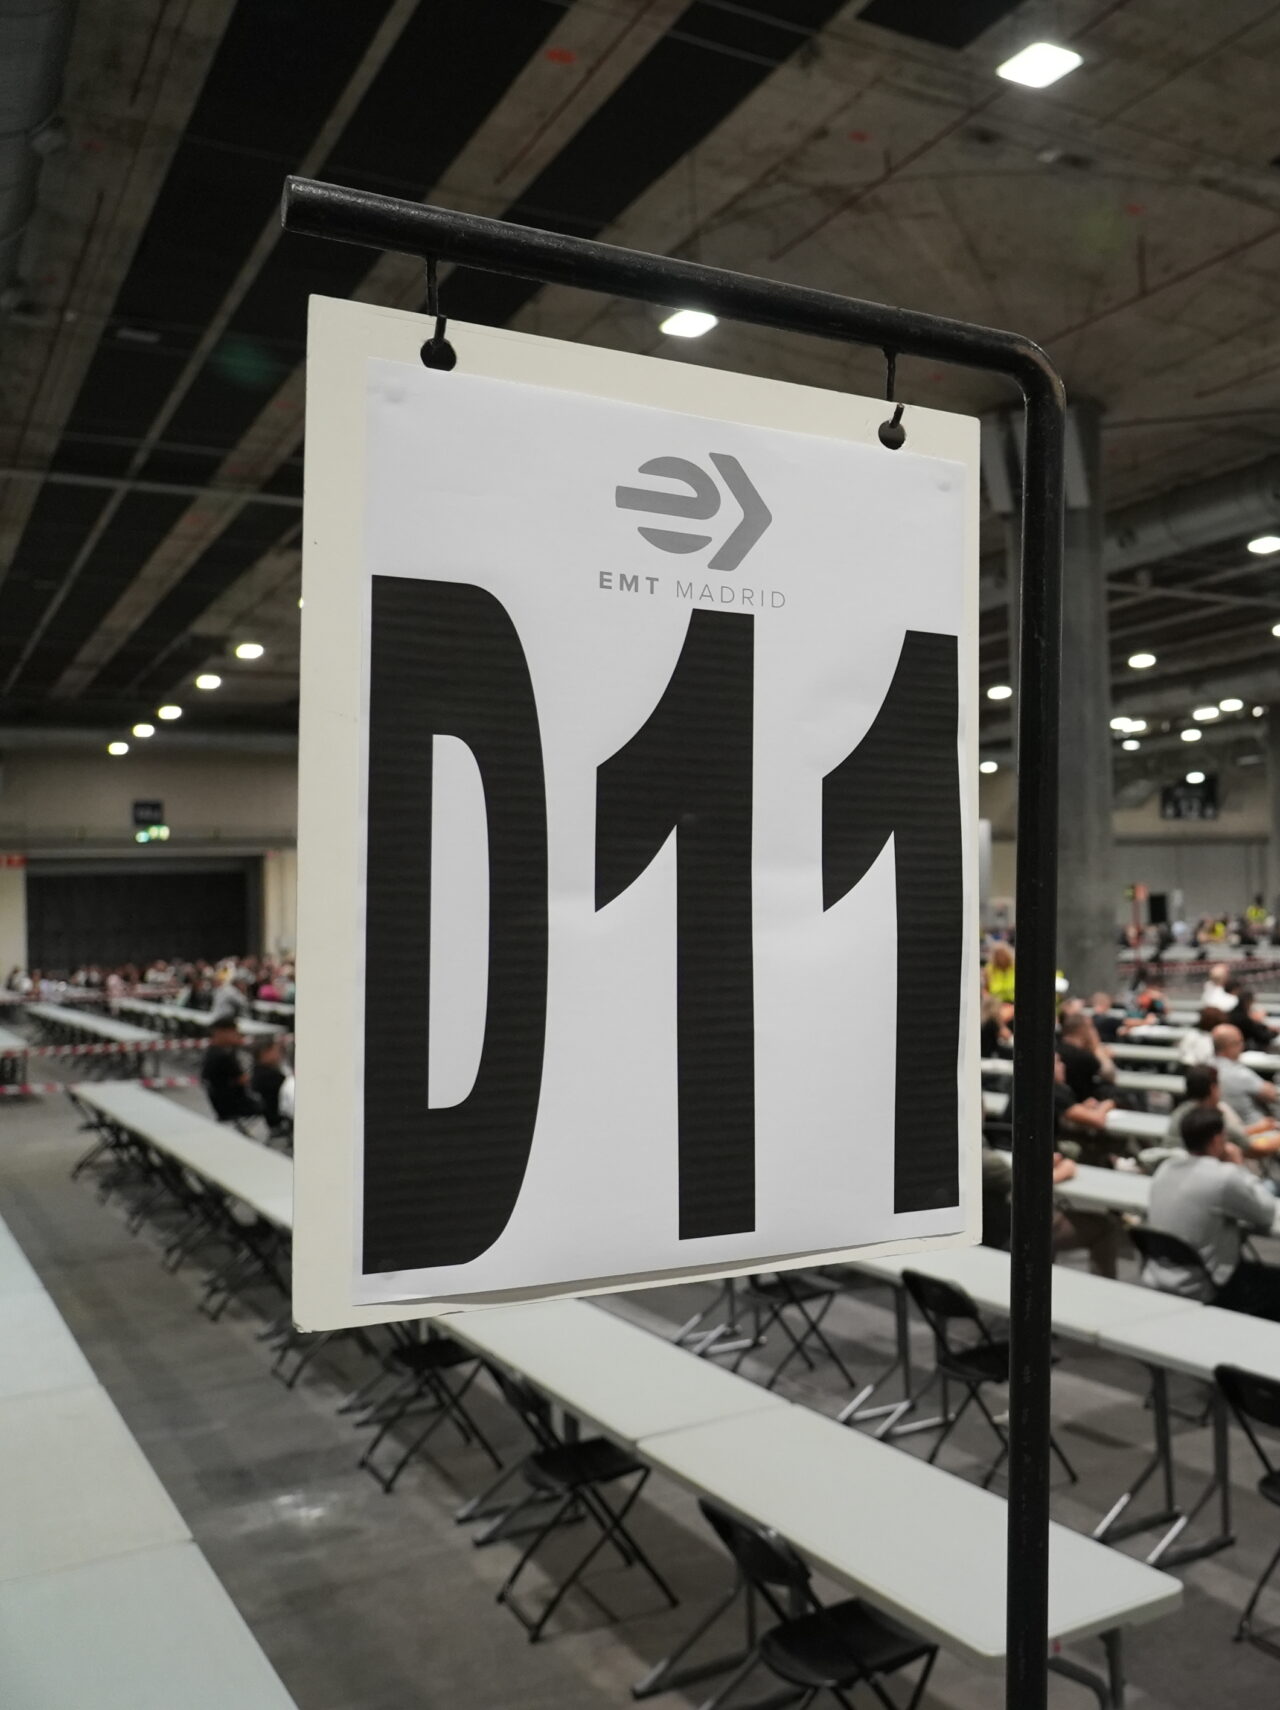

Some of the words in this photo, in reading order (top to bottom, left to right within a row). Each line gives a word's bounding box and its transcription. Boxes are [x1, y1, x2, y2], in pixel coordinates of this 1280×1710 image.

[599, 571, 659, 595] EMT
[676, 580, 786, 609] MADRID
[362, 575, 964, 1274] D11
